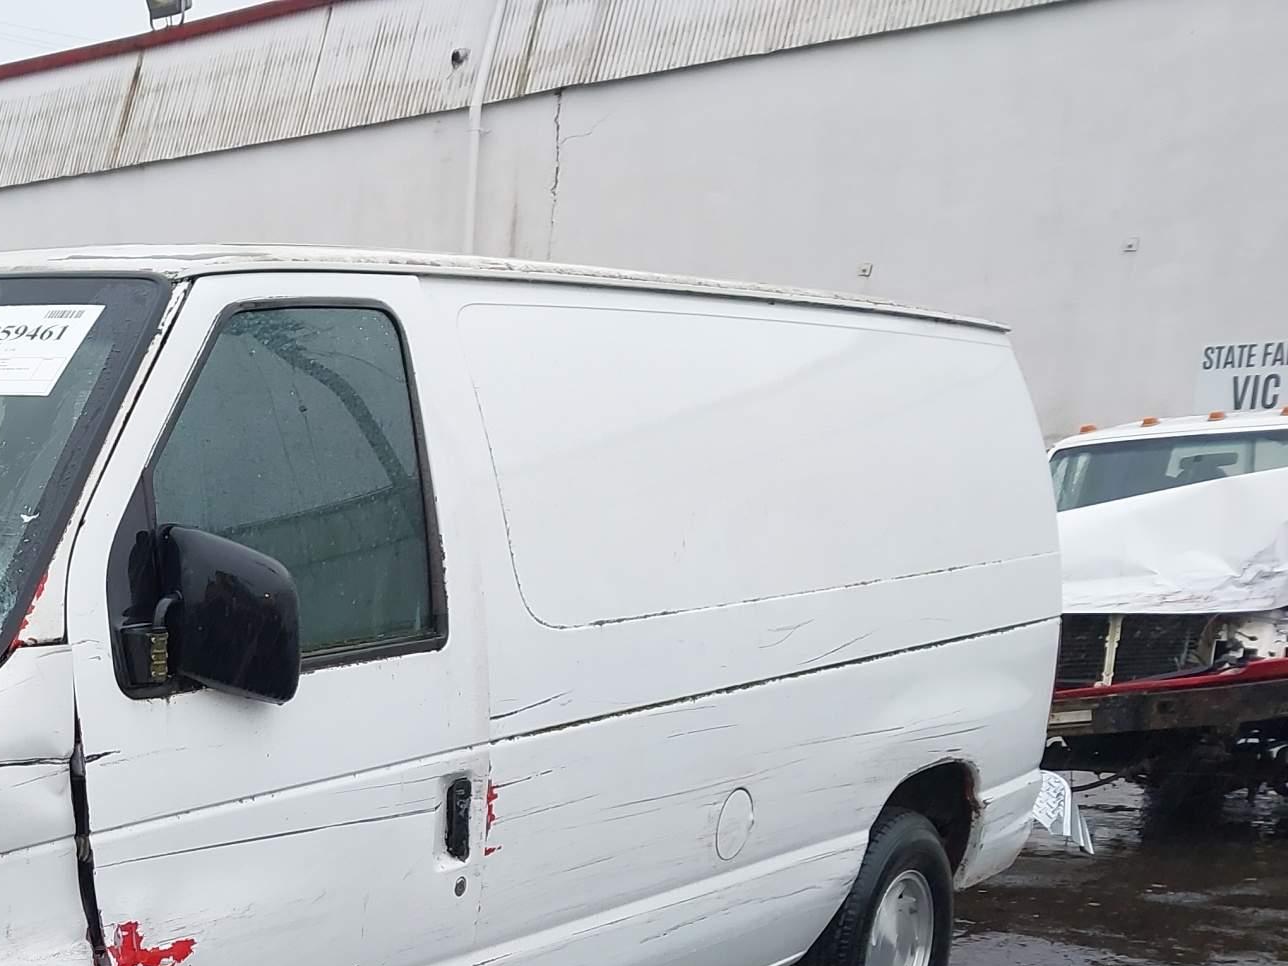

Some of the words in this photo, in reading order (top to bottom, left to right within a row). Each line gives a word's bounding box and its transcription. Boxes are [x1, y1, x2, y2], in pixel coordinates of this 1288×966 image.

[1203, 344, 1258, 370] STATE
[1261, 341, 1288, 367] FA
[1232, 373, 1281, 410] VIC
